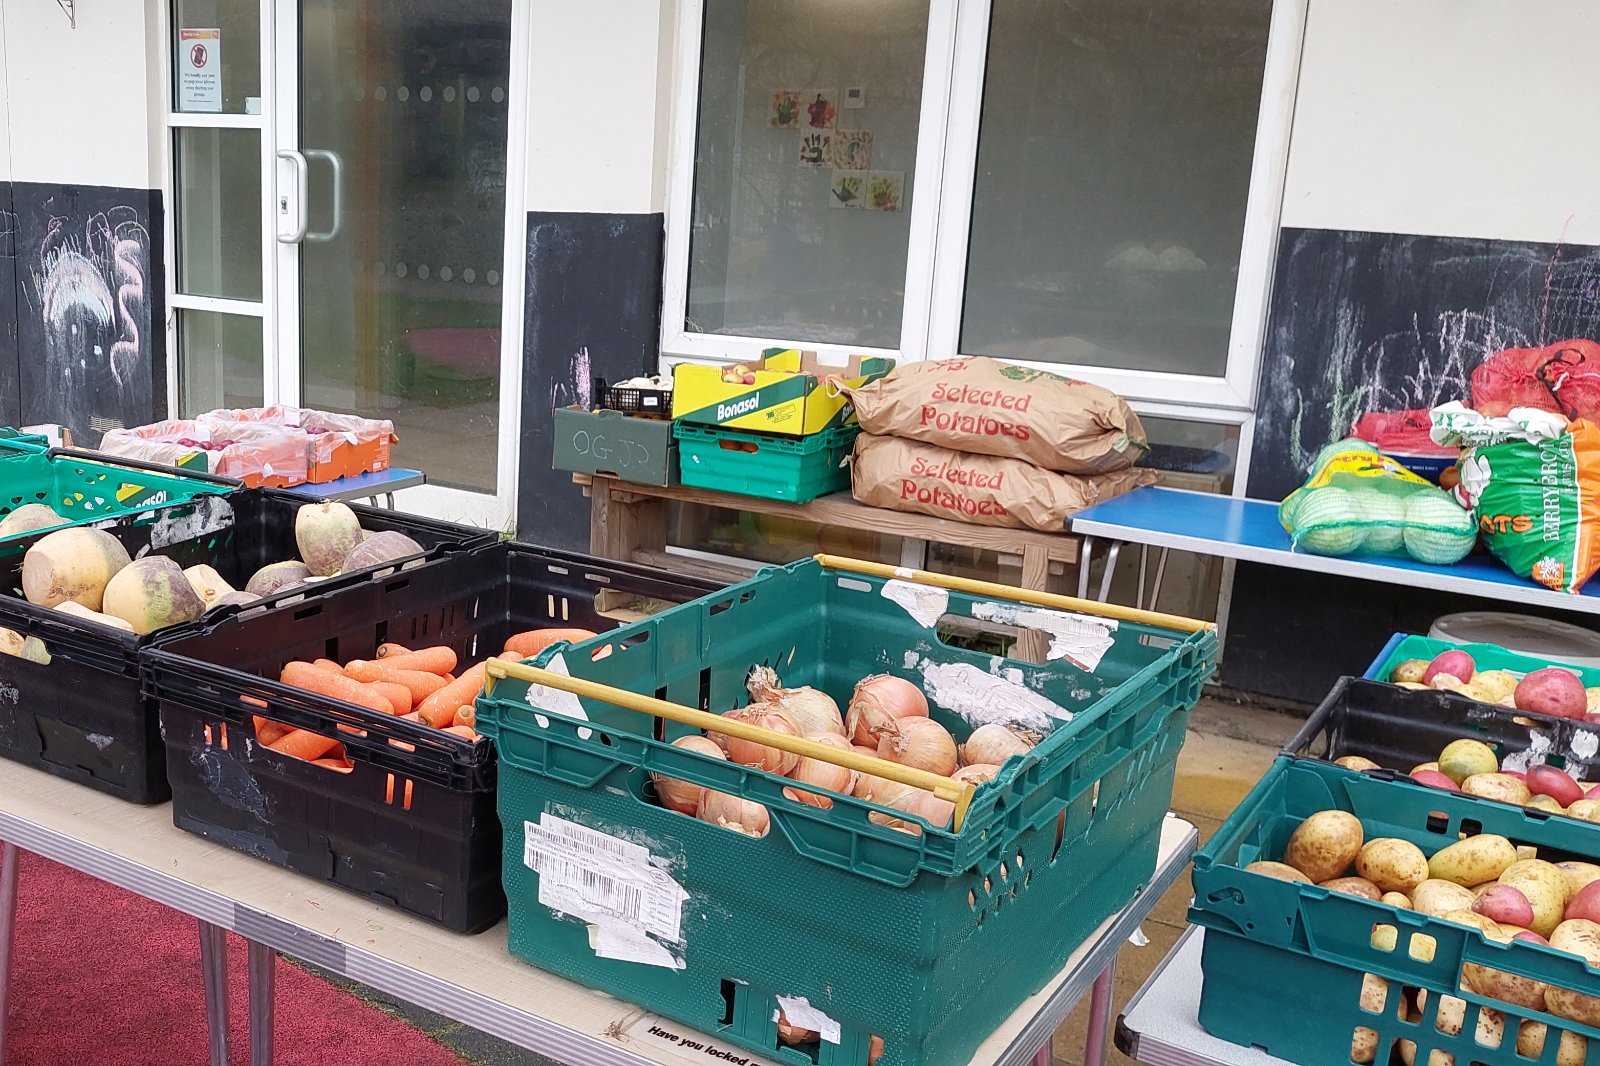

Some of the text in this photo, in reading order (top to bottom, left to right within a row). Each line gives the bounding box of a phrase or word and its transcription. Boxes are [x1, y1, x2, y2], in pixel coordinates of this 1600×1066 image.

[716, 392, 760, 422] Bonasol
[931, 382, 1032, 413] Selected
[920, 404, 1031, 442] Potatoes
[910, 456, 1004, 490] Selected
[900, 478, 1008, 516] Potatoes
[1480, 514, 1534, 534] OTS
[646, 1026, 750, 1066] Have you locked
